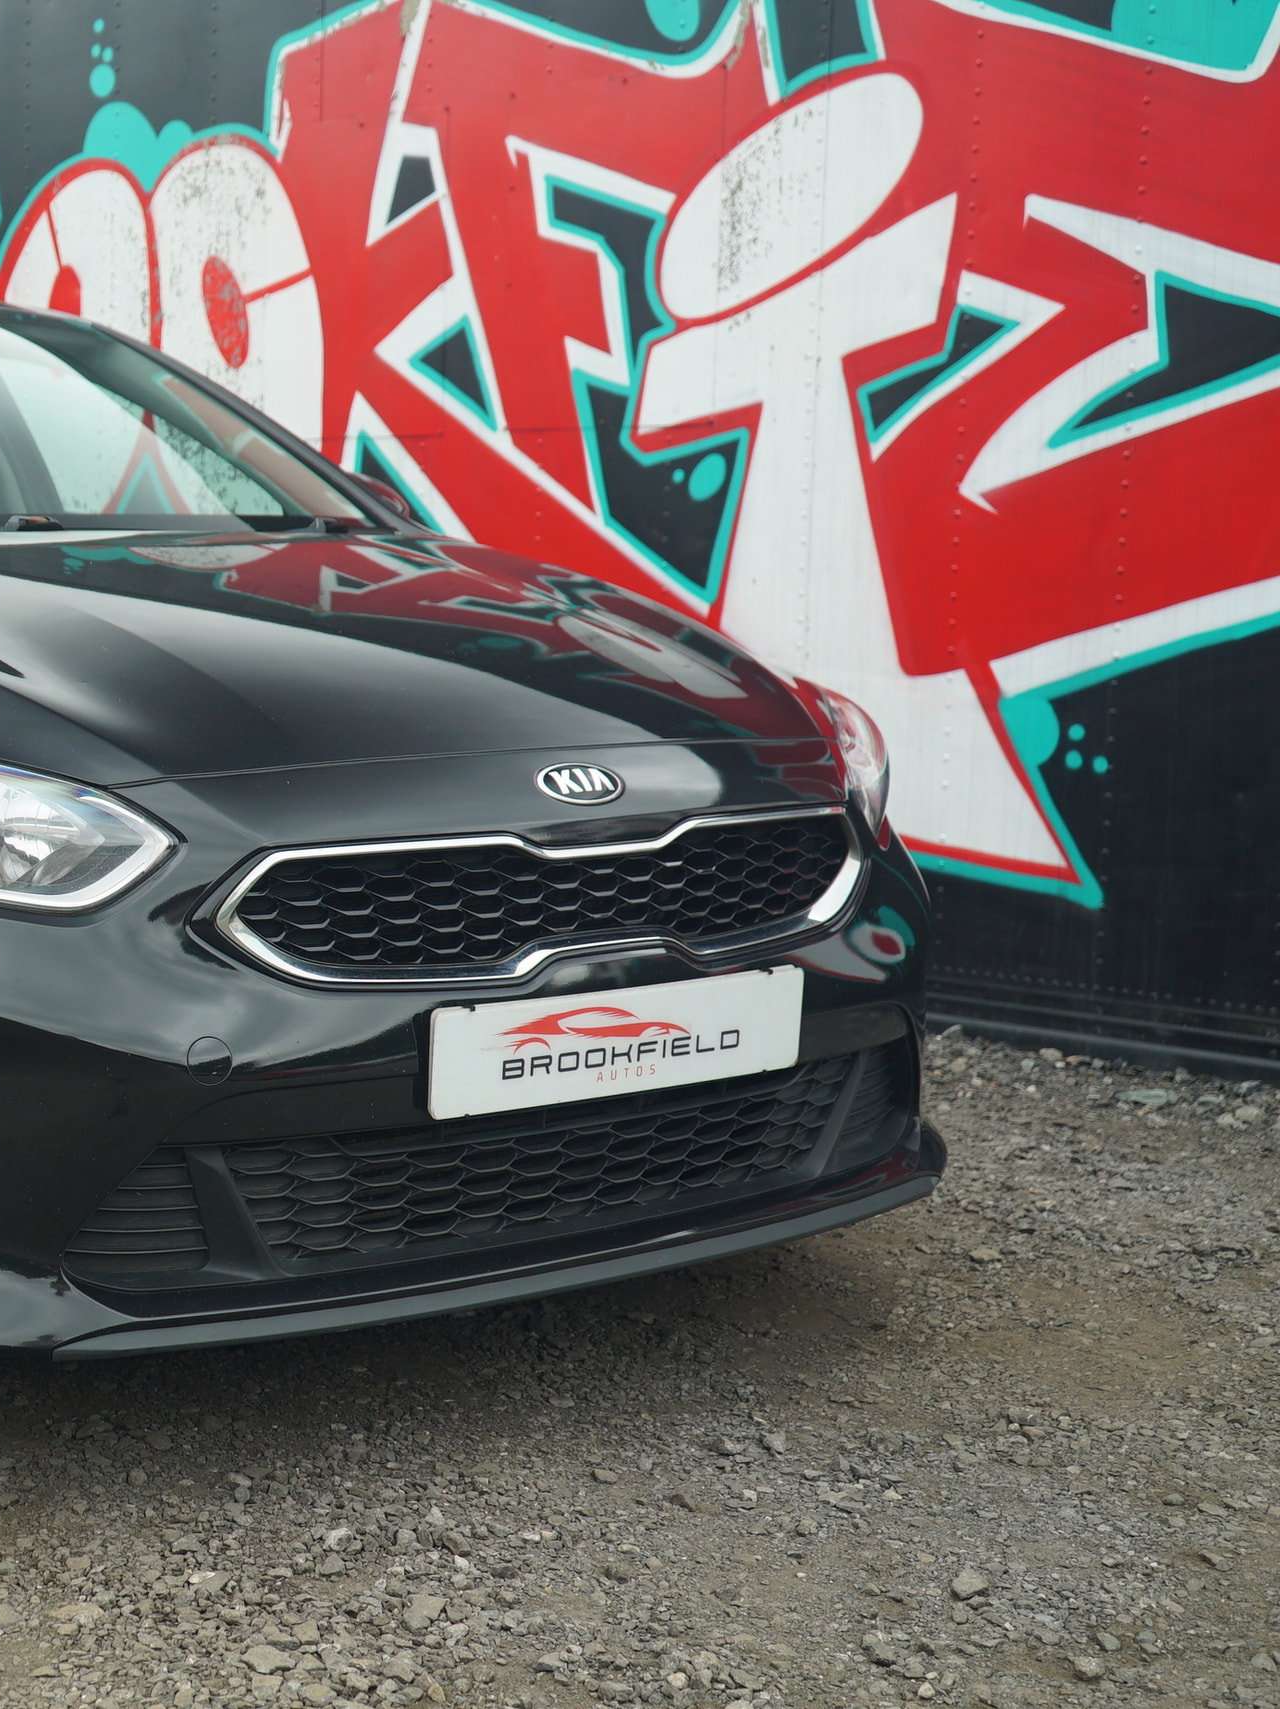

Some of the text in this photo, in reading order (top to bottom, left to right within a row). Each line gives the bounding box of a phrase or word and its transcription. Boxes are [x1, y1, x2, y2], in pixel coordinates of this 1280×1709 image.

[548, 767, 616, 795] KIA
[501, 1028, 740, 1081] BROOKFIELD
[596, 1064, 657, 1083] AUTOS
